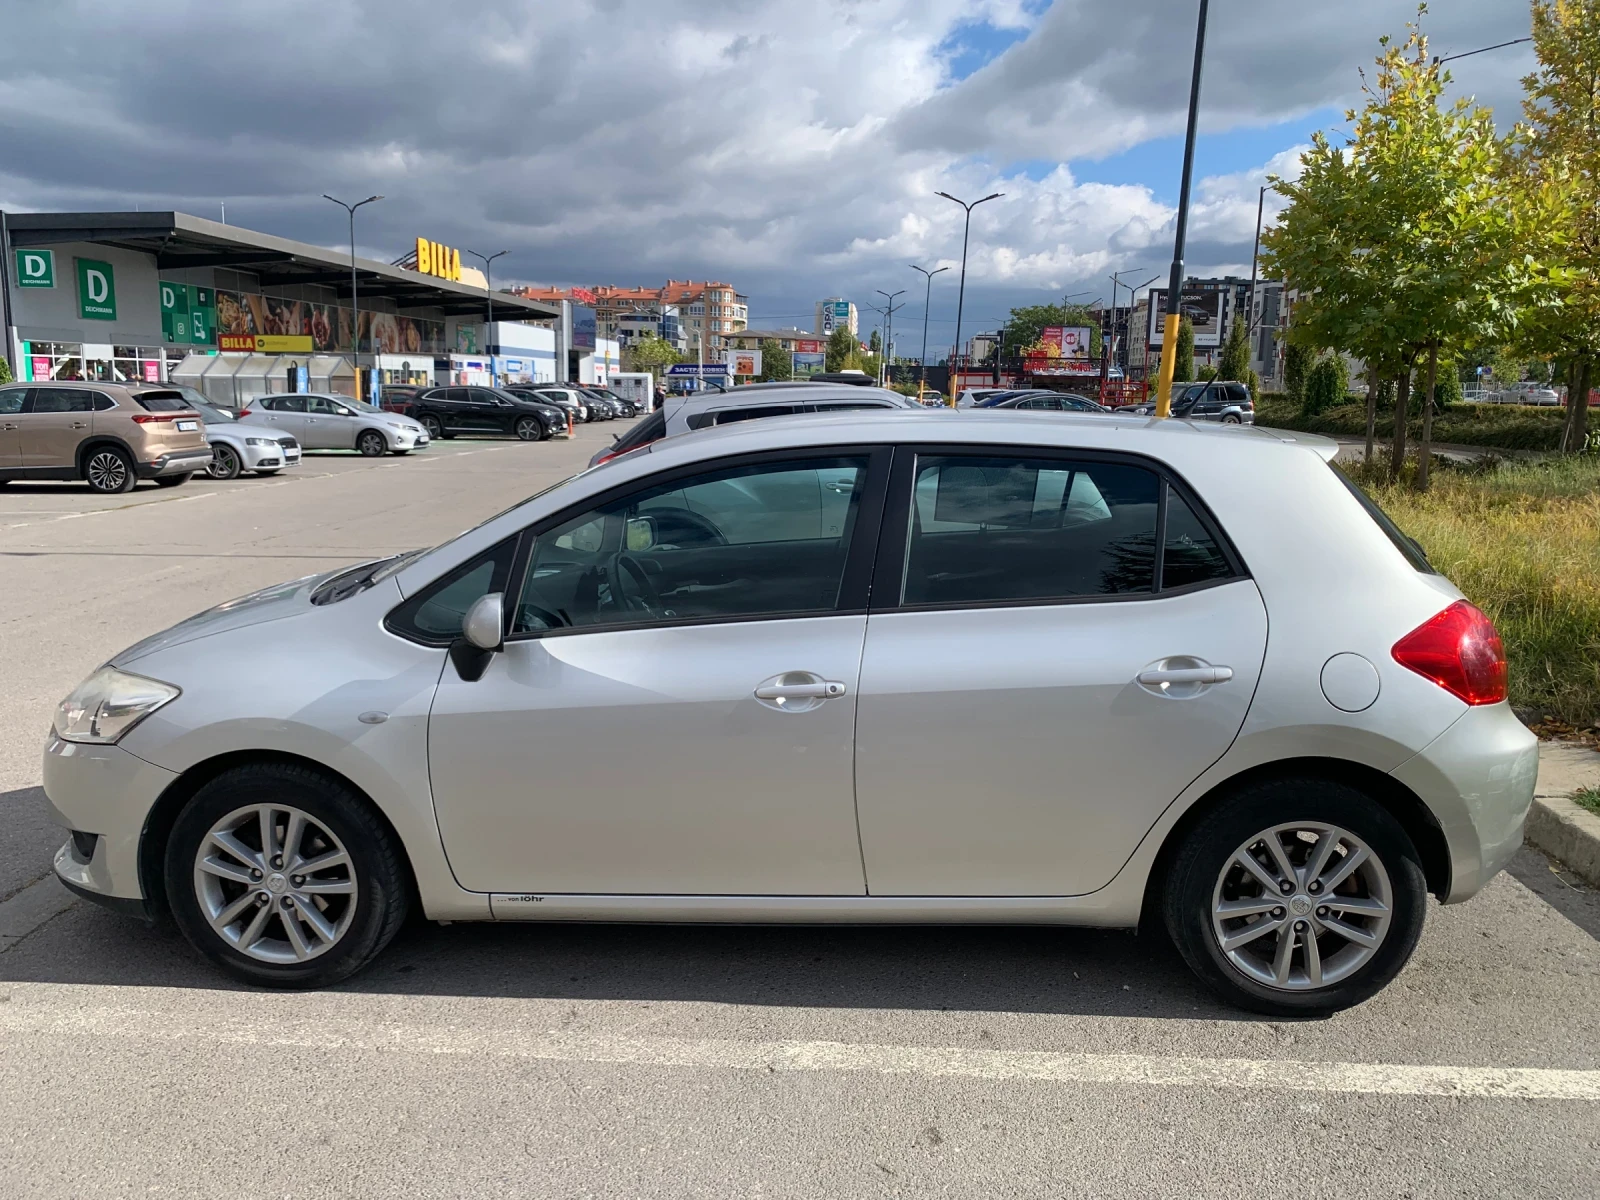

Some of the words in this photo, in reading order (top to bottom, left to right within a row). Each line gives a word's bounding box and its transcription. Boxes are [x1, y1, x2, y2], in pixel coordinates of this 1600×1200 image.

[25, 255, 46, 277] D
[416, 237, 461, 282] BILLA
[87, 269, 108, 303] D
[162, 287, 175, 308] D
[85, 305, 113, 314] DEICHMANN
[221, 337, 254, 349] BILLA
